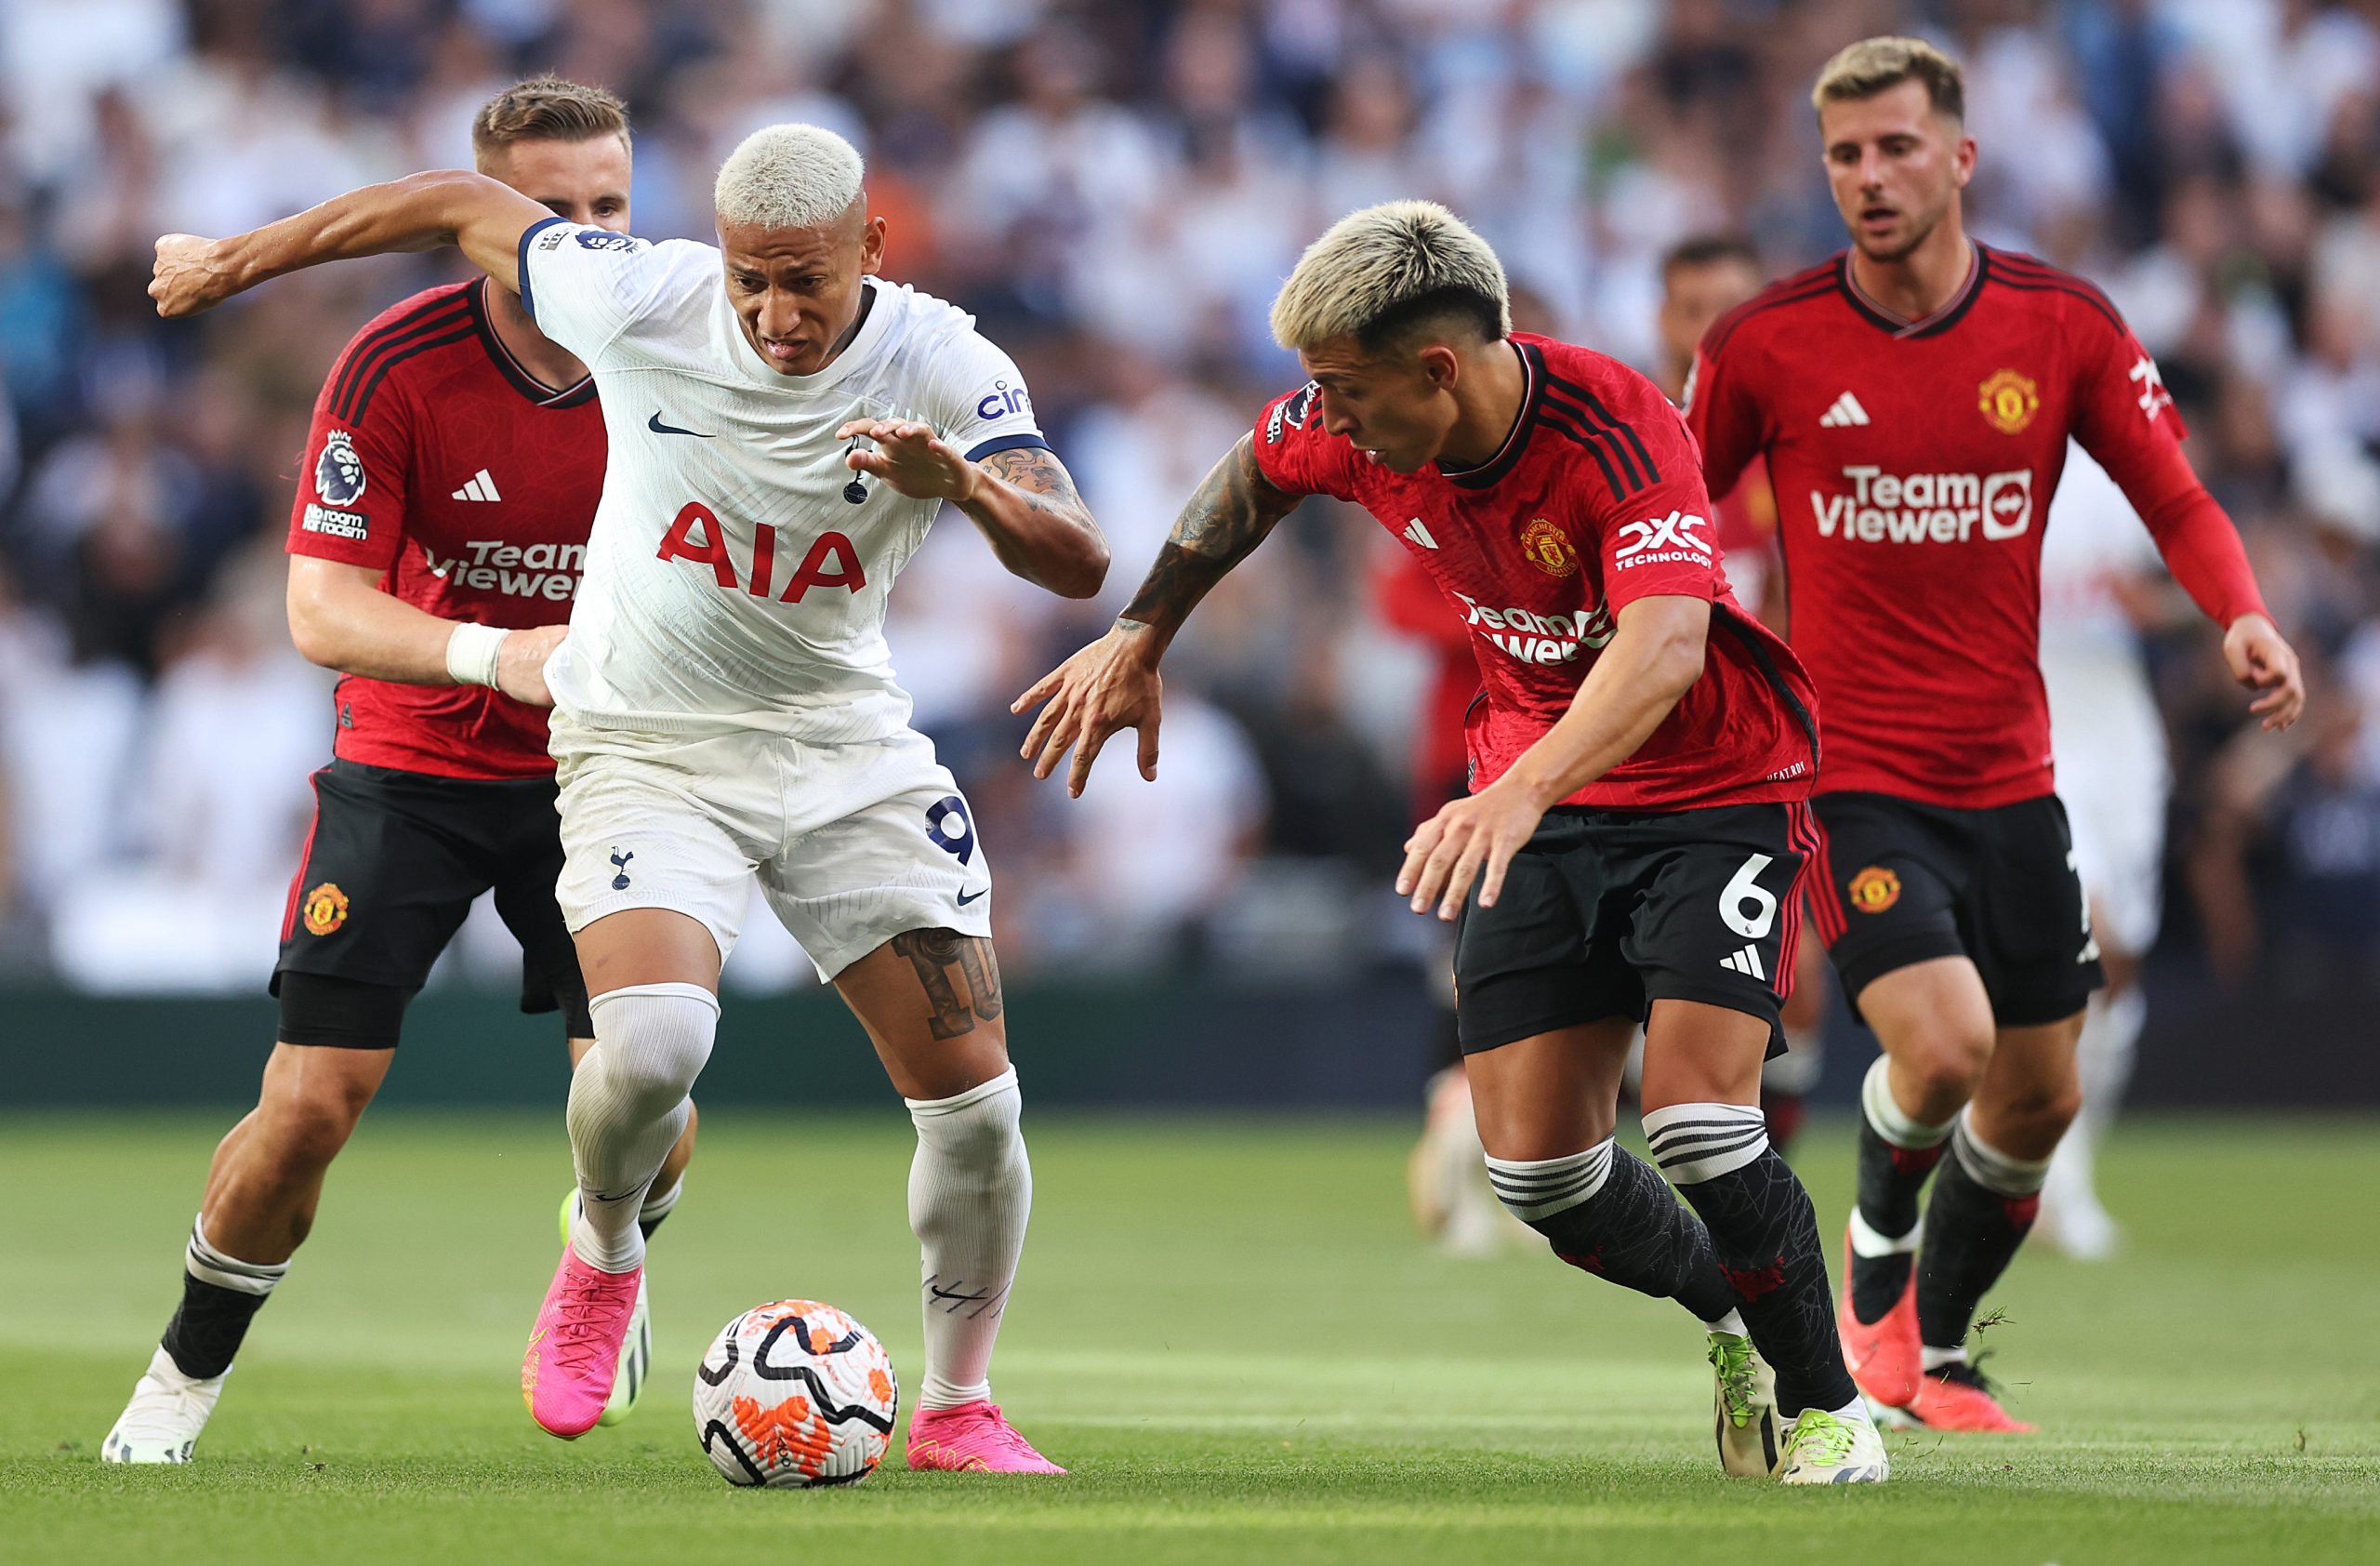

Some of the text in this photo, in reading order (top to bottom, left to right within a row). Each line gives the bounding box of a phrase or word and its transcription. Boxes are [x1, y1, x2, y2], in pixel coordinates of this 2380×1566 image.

[1843, 465, 1980, 509] Team
[304, 503, 363, 527] No room
[321, 522, 367, 540] racism
[1616, 511, 1712, 559] DXC
[1810, 490, 1980, 543] Viewer
[656, 501, 866, 603] AIA
[1615, 551, 1712, 571] TECHNOLOGY
[925, 795, 974, 867] 9
[1718, 853, 1777, 939] 6
